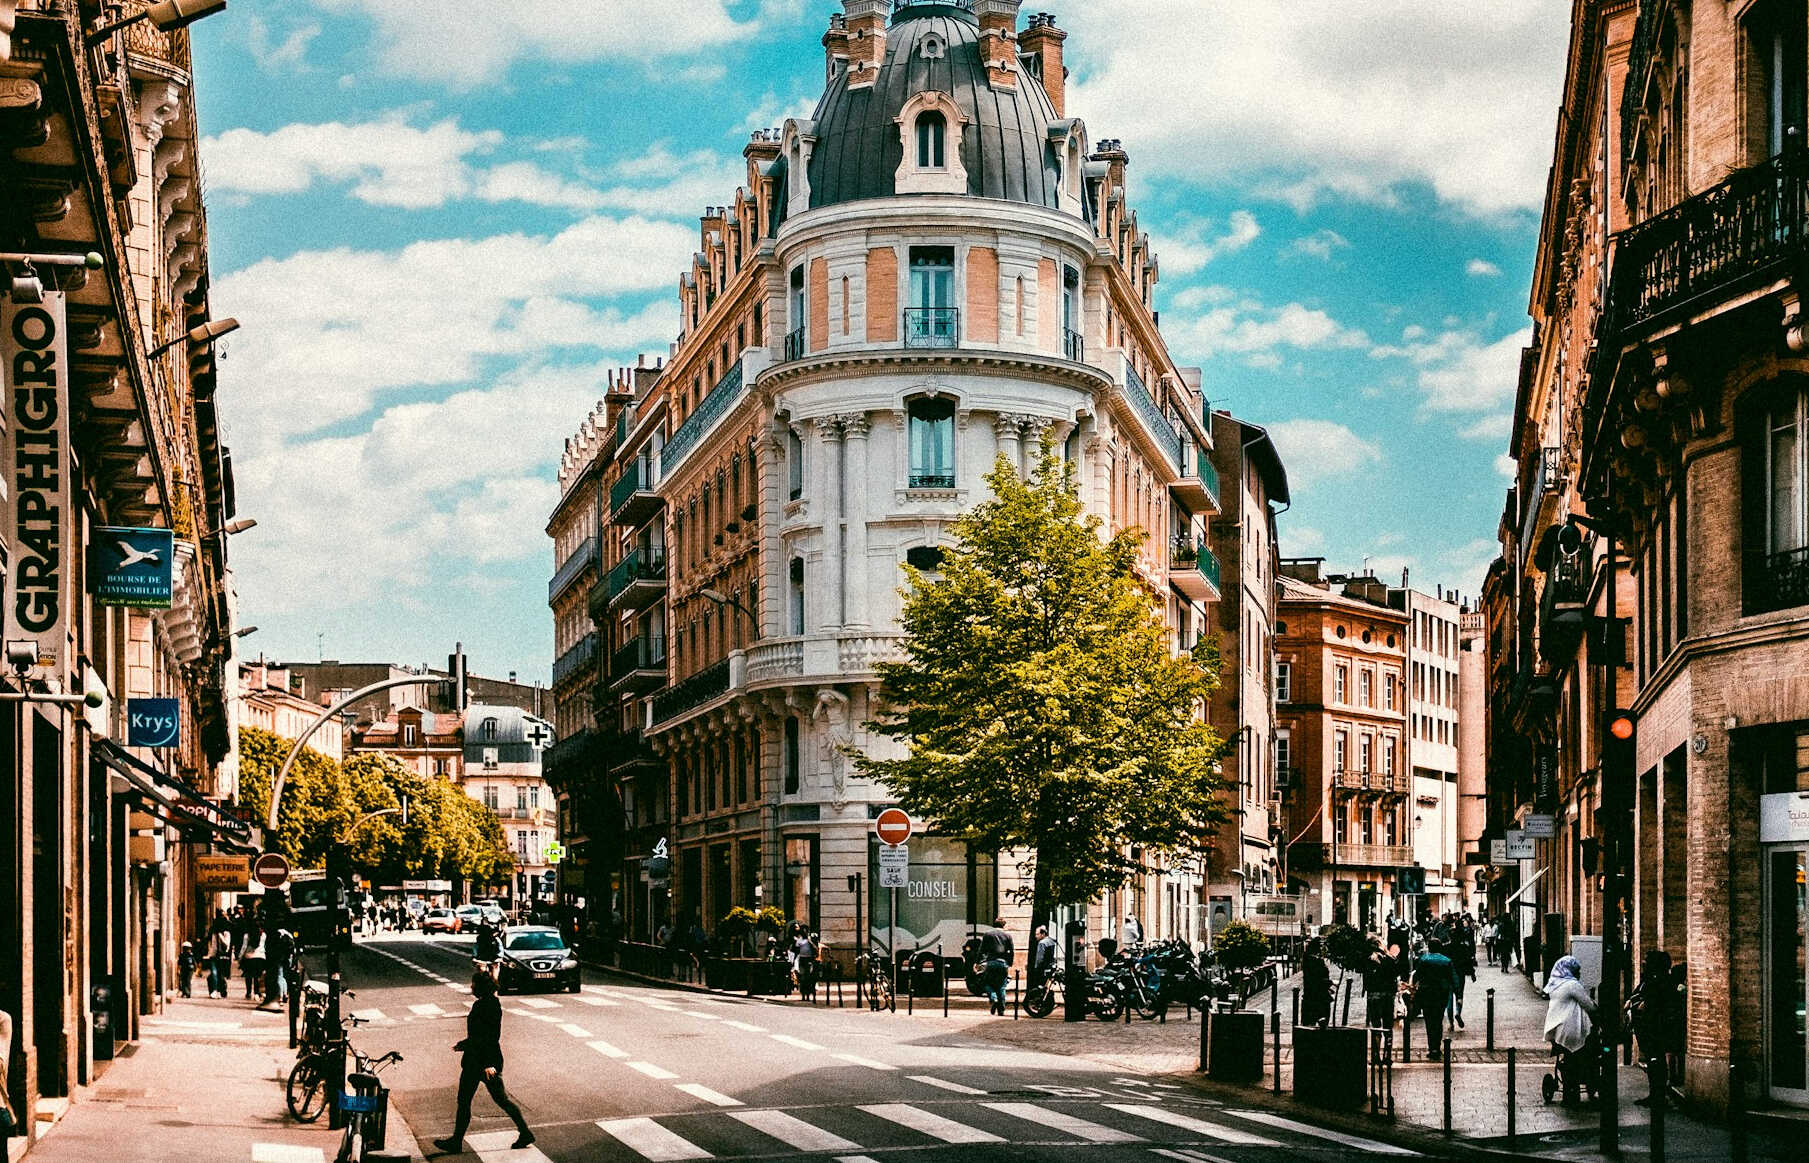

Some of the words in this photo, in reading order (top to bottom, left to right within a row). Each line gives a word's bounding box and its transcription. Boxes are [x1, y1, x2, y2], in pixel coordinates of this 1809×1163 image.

[12, 307, 59, 633] GRAPHIGRO
[107, 575, 146, 584] BOURSE
[148, 576, 162, 584] DE
[98, 586, 170, 595] L'IMMOBILIER
[132, 712, 173, 734] Krys
[199, 863, 246, 872] PAPETERIE
[207, 875, 238, 884] OSCAR
[908, 880, 958, 898] CONSEIL
